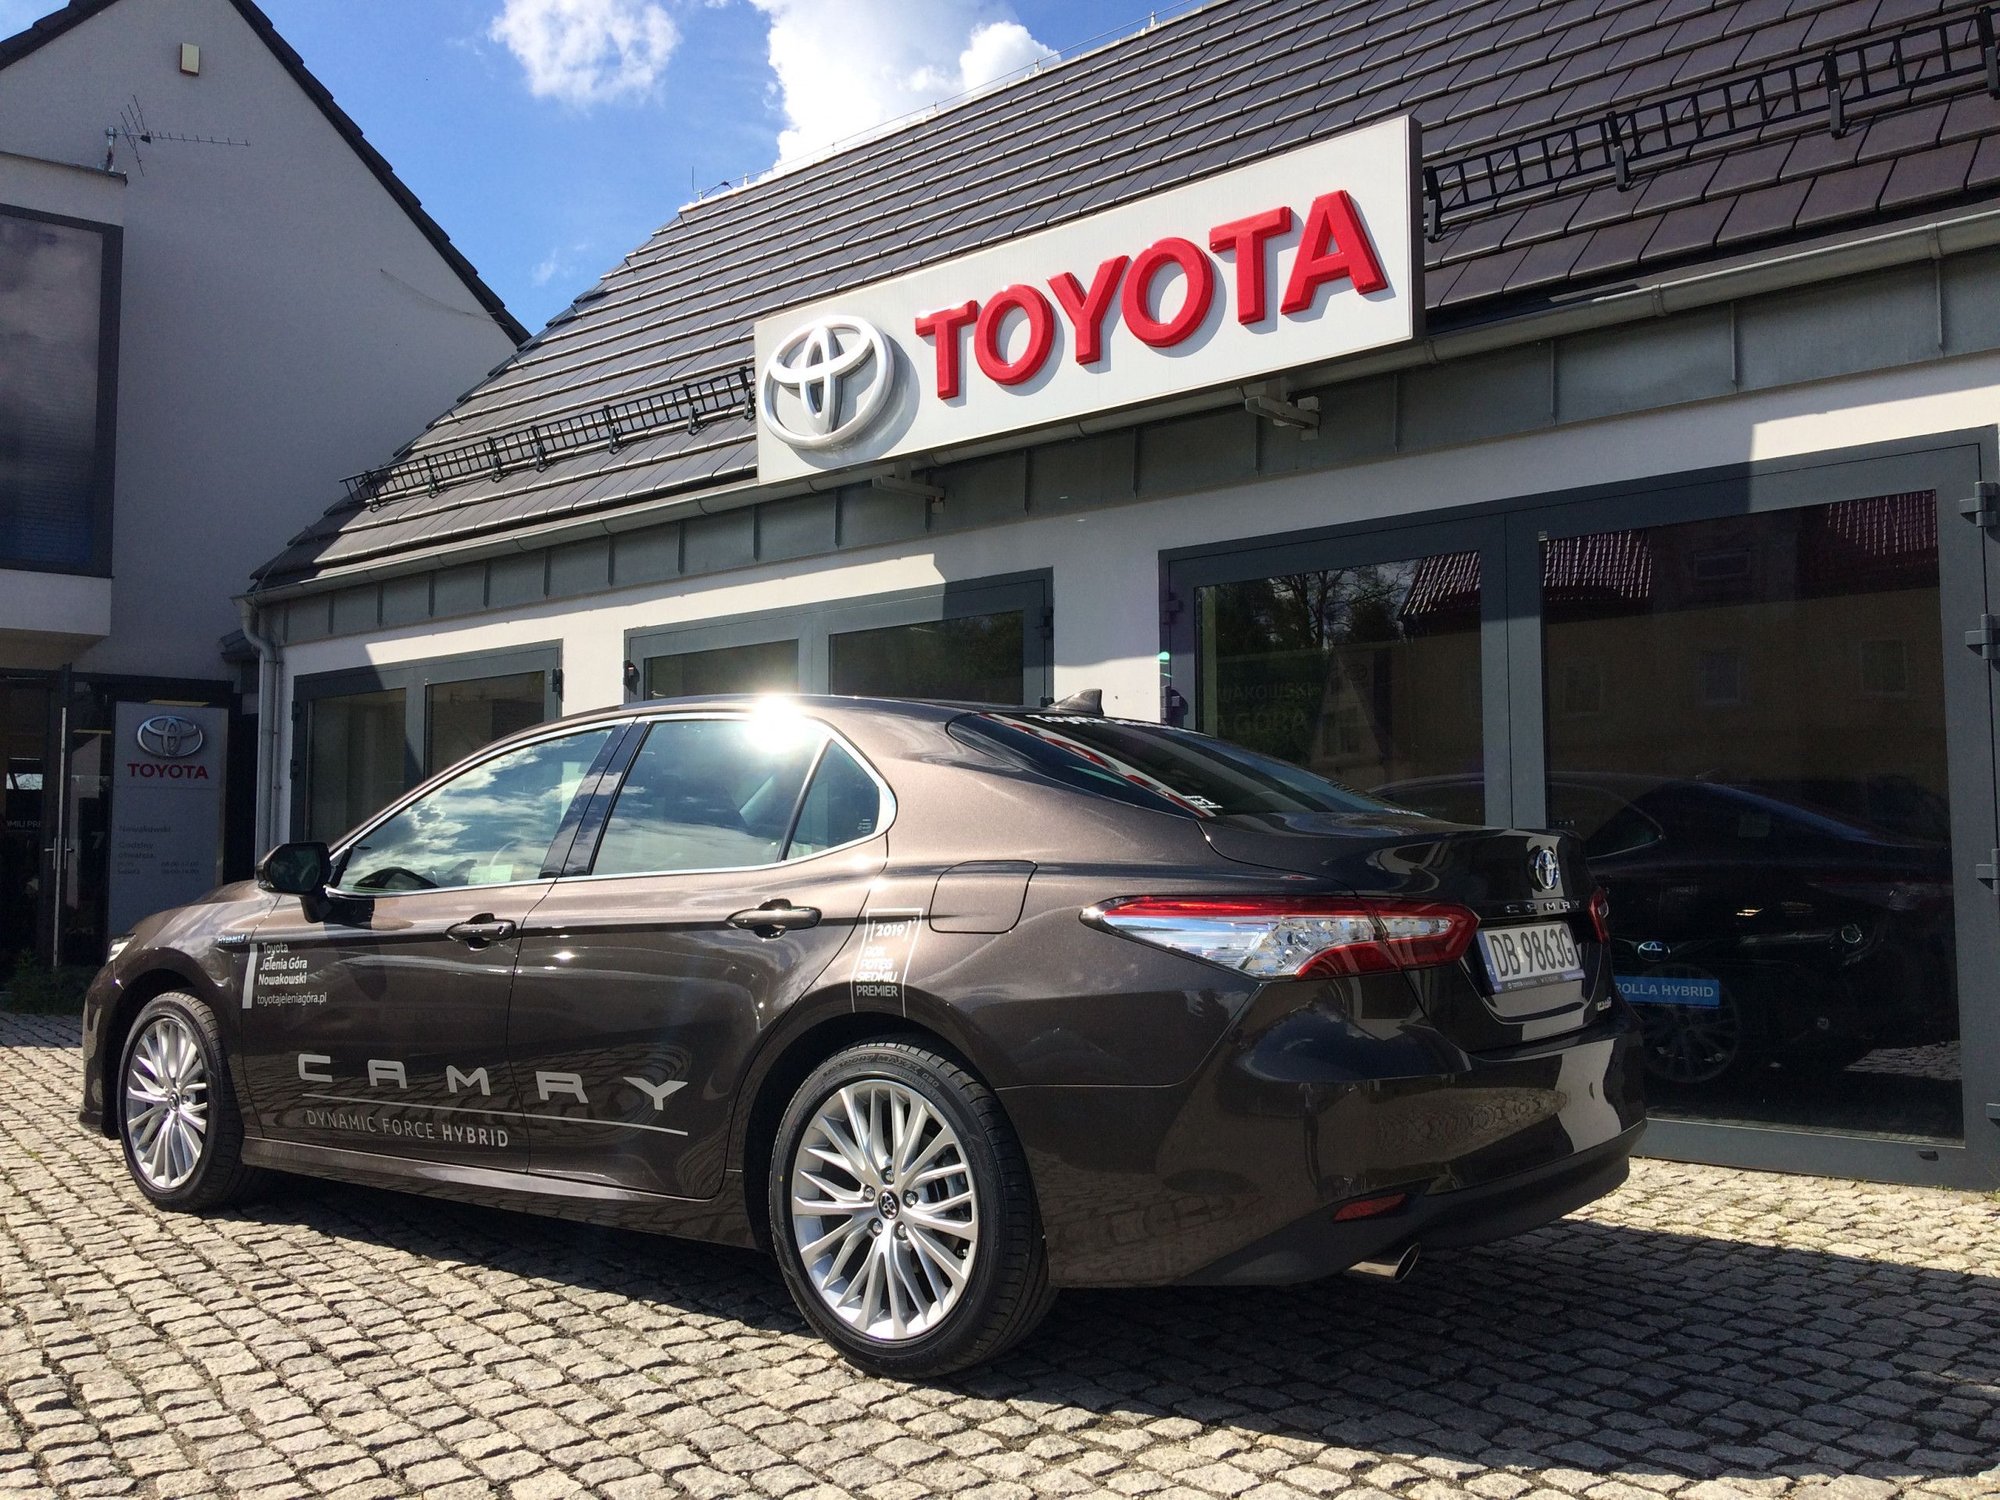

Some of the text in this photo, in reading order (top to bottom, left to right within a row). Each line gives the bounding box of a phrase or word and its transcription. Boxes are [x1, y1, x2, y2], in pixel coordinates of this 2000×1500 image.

[915, 189, 1388, 399] TOYOTA
[127, 763, 209, 779] TOYOTA
[1506, 900, 1580, 913] CAMRY
[876, 924, 905, 937] 2019
[262, 942, 289, 956] Toyota
[1489, 927, 1575, 977] DB 9863G
[260, 956, 308, 971] Jelenia Góra
[258, 972, 307, 986] Nowakowski
[856, 985, 898, 997] PREMIER
[1661, 984, 1714, 998] HYBRID
[298, 1053, 689, 1111] CAMRY
[306, 1110, 509, 1148] DYNAMIC FORCE HYBRID
